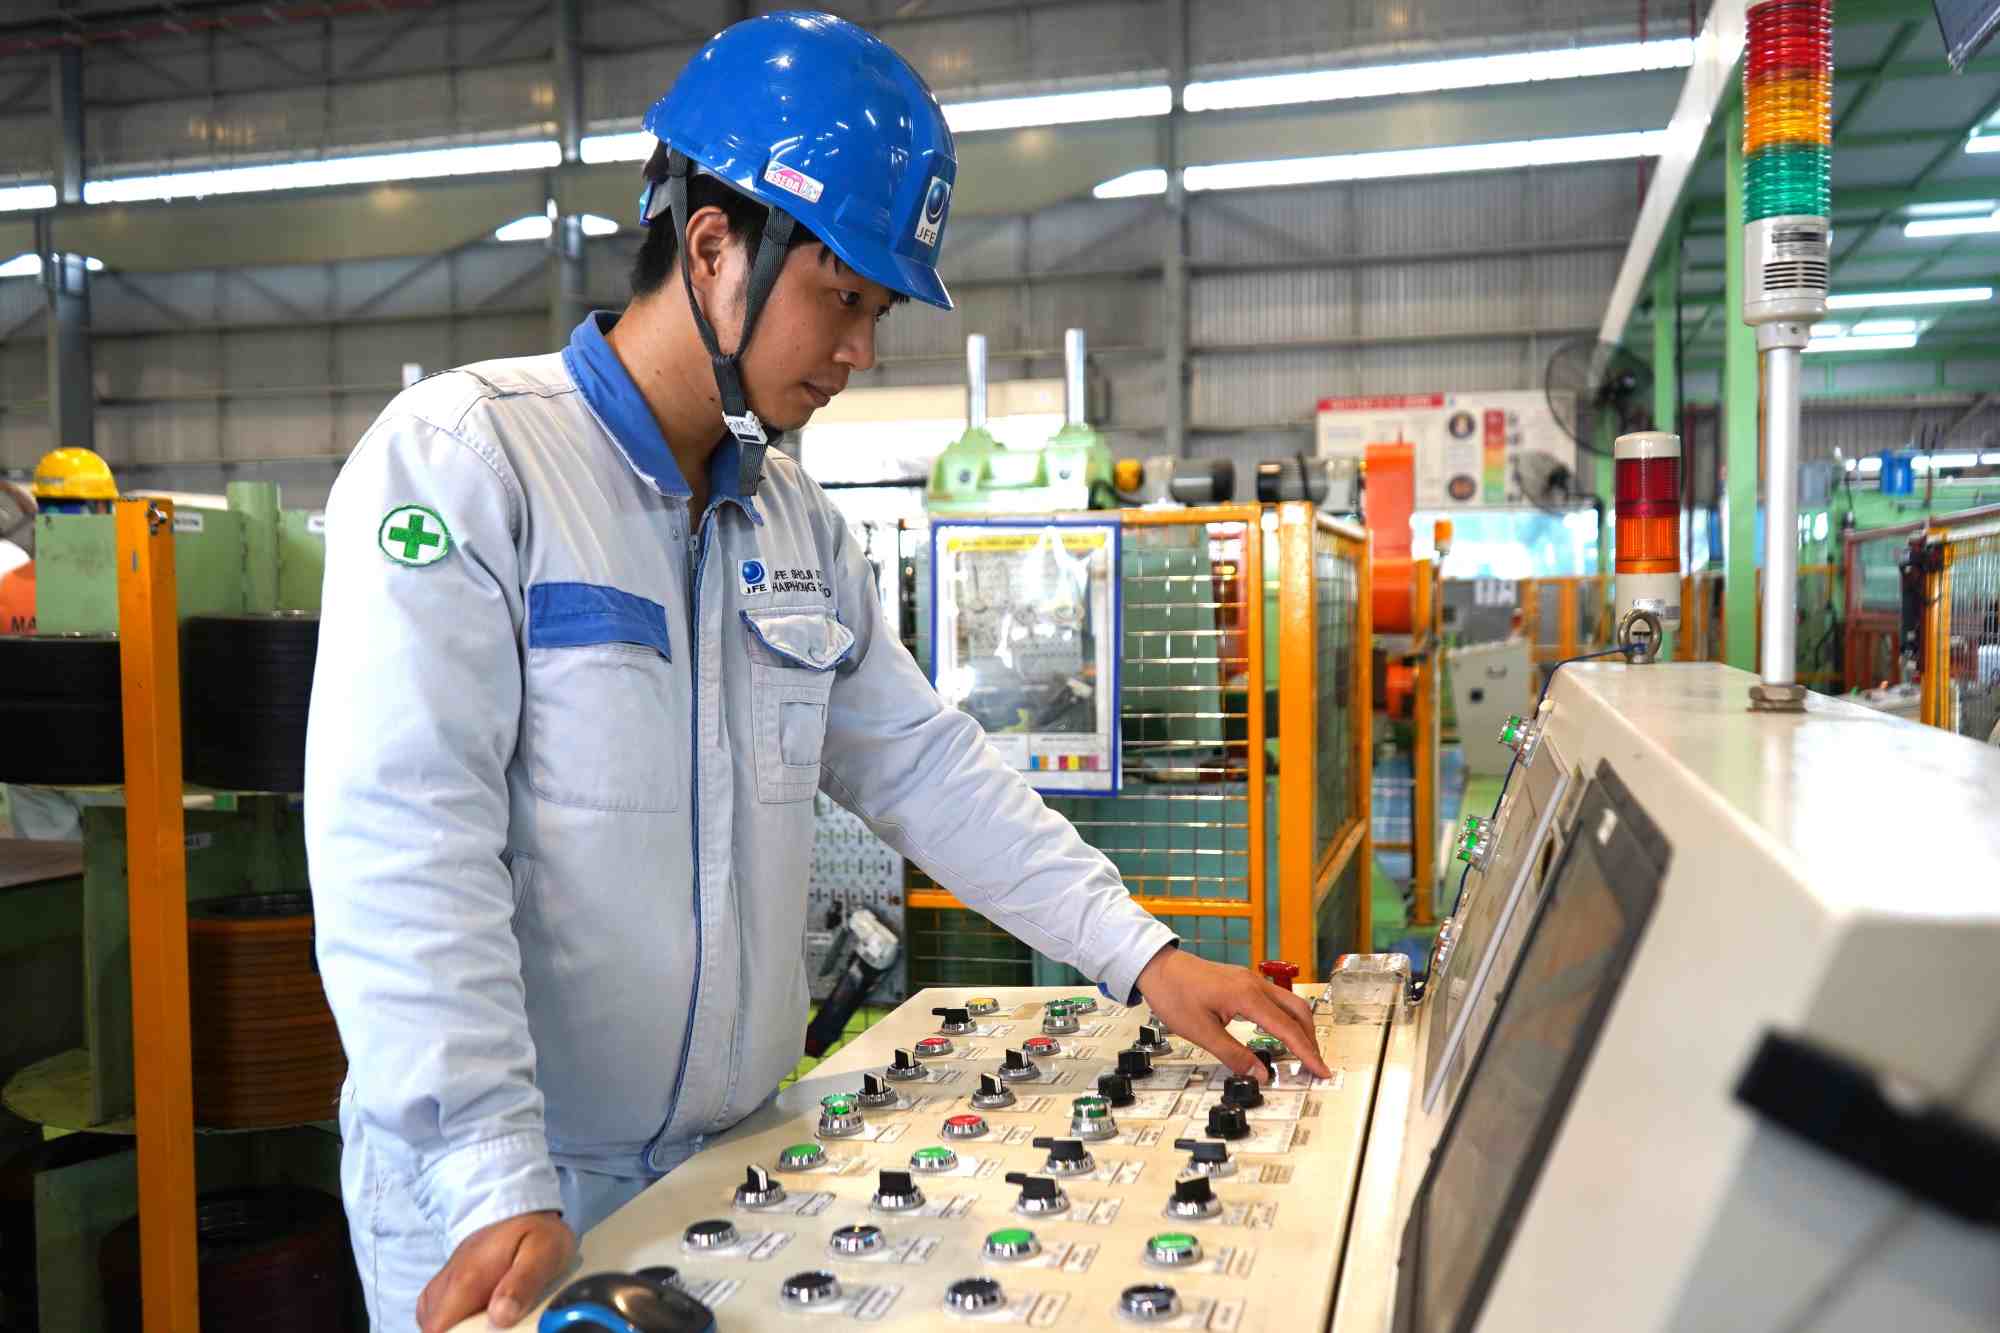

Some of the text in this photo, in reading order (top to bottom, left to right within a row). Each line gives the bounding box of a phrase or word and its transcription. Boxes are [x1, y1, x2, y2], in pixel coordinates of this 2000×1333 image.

[917, 226, 937, 245] JFE
[744, 584, 768, 595] JFE
[772, 581, 816, 593] HAIPHONG
